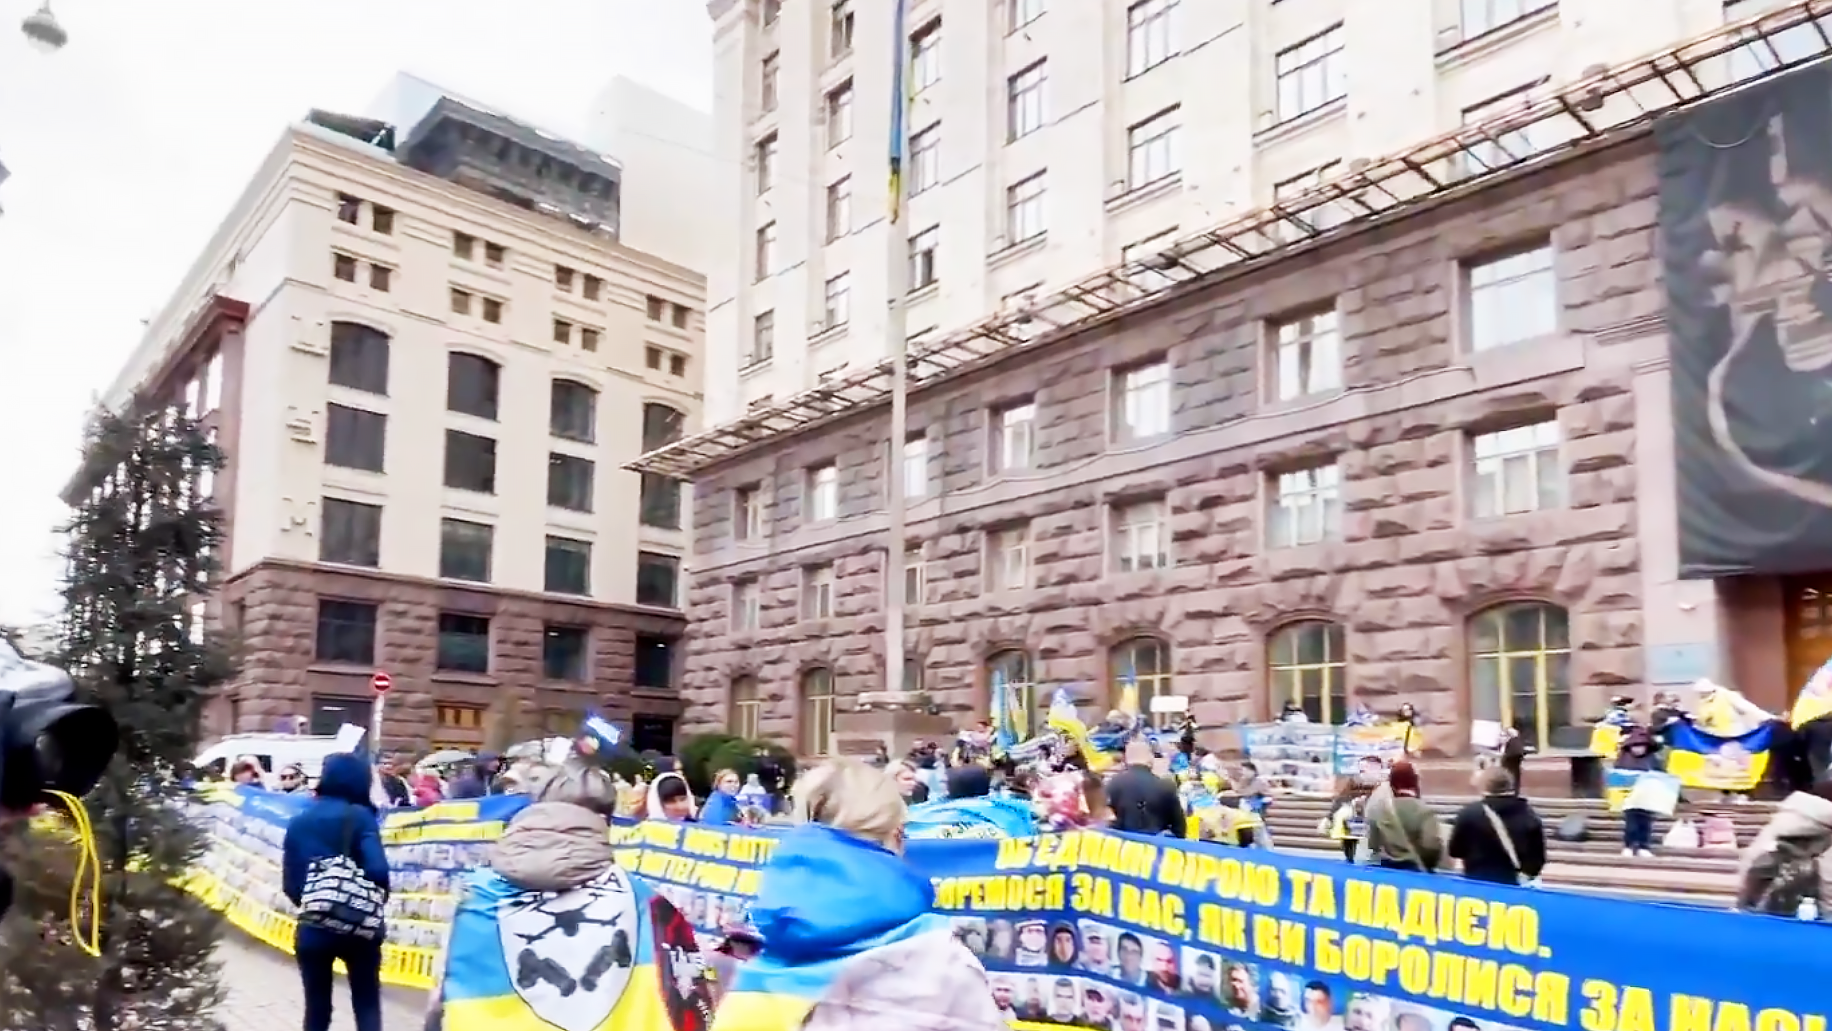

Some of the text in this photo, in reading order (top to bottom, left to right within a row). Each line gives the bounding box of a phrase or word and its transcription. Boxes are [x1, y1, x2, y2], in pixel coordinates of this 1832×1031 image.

[1071, 873, 1114, 916] ЗА
[1199, 904, 1246, 951] ЯК
[1255, 914, 1306, 963] ВИ
[1315, 929, 1569, 1026] БОРОЛИСЯ
[1580, 979, 1655, 1031] ЗА
[1158, 847, 1280, 904] ВІРОЮ
[1288, 870, 1335, 918] ТА
[1344, 880, 1552, 957] НАДІЄЮ.
